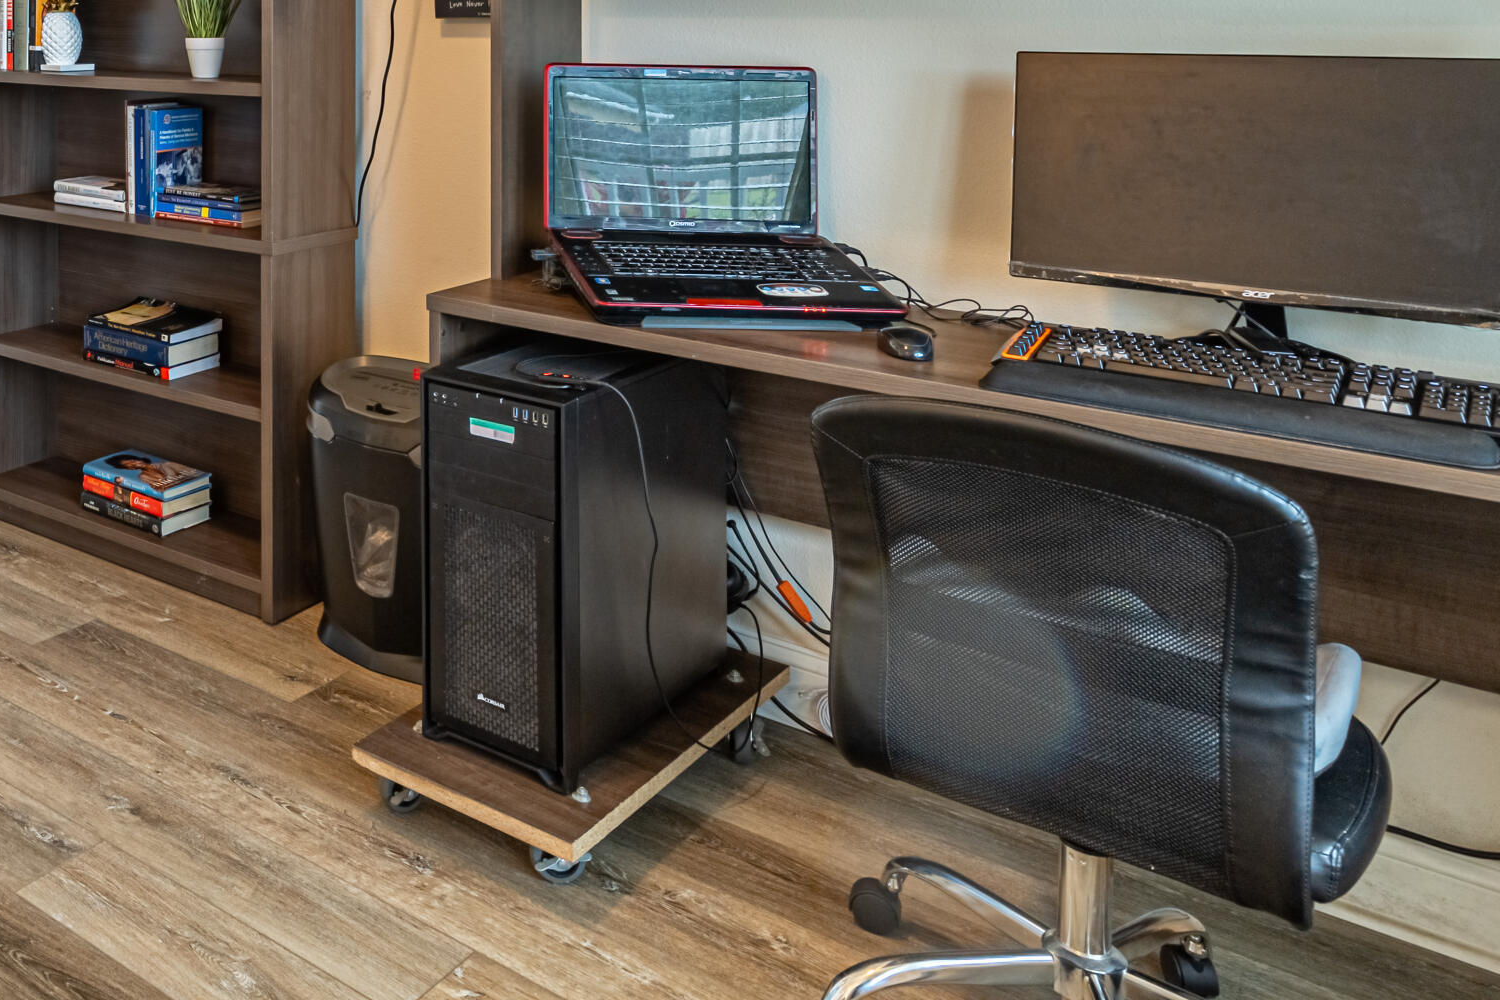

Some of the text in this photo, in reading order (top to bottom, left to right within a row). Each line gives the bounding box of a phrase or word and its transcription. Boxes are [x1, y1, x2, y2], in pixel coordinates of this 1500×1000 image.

[449, 0, 484, 9] Love Never
[1242, 290, 1276, 299] acer
[94, 332, 148, 352] American Heritage
[98, 341, 127, 355] Dictionary
[114, 359, 134, 369] Manual
